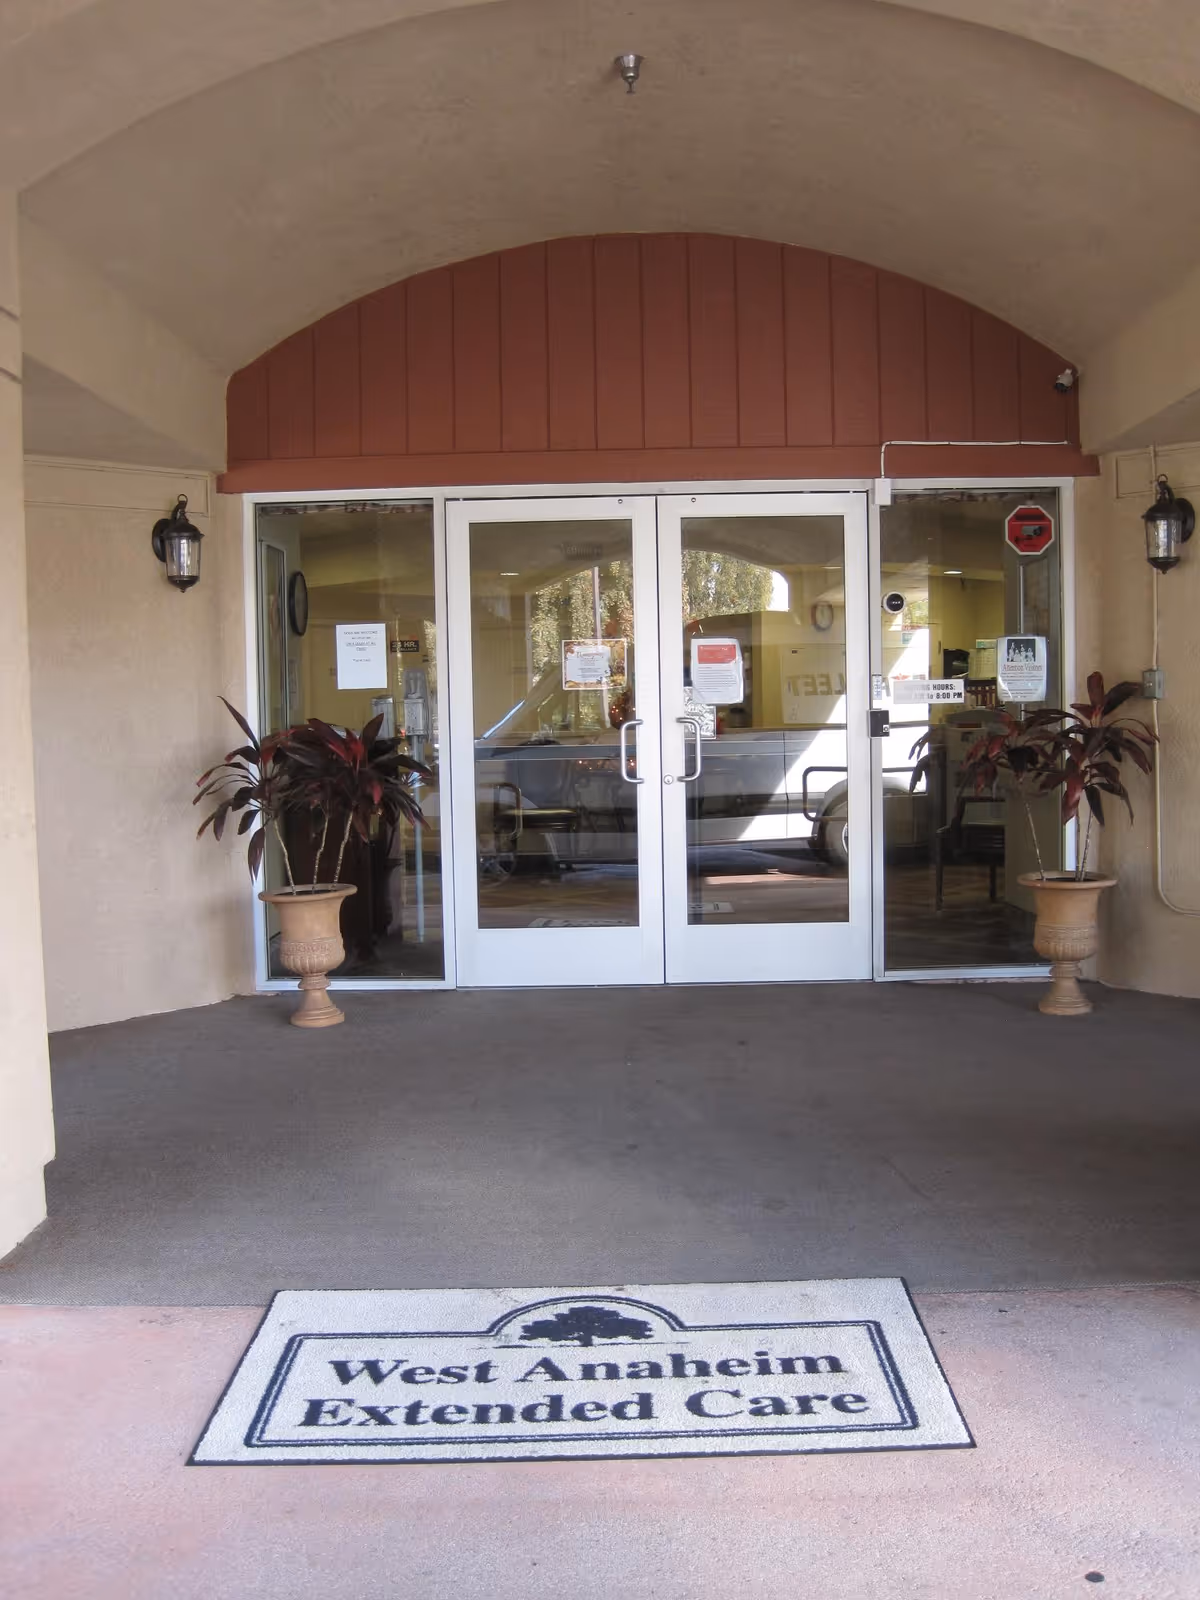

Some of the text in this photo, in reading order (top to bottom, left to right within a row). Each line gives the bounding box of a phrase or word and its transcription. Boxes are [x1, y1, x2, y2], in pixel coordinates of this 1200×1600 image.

[932, 683, 956, 691] HOURS:
[327, 1350, 848, 1386] West Anaheim
[297, 1388, 871, 1426] Extended Care
